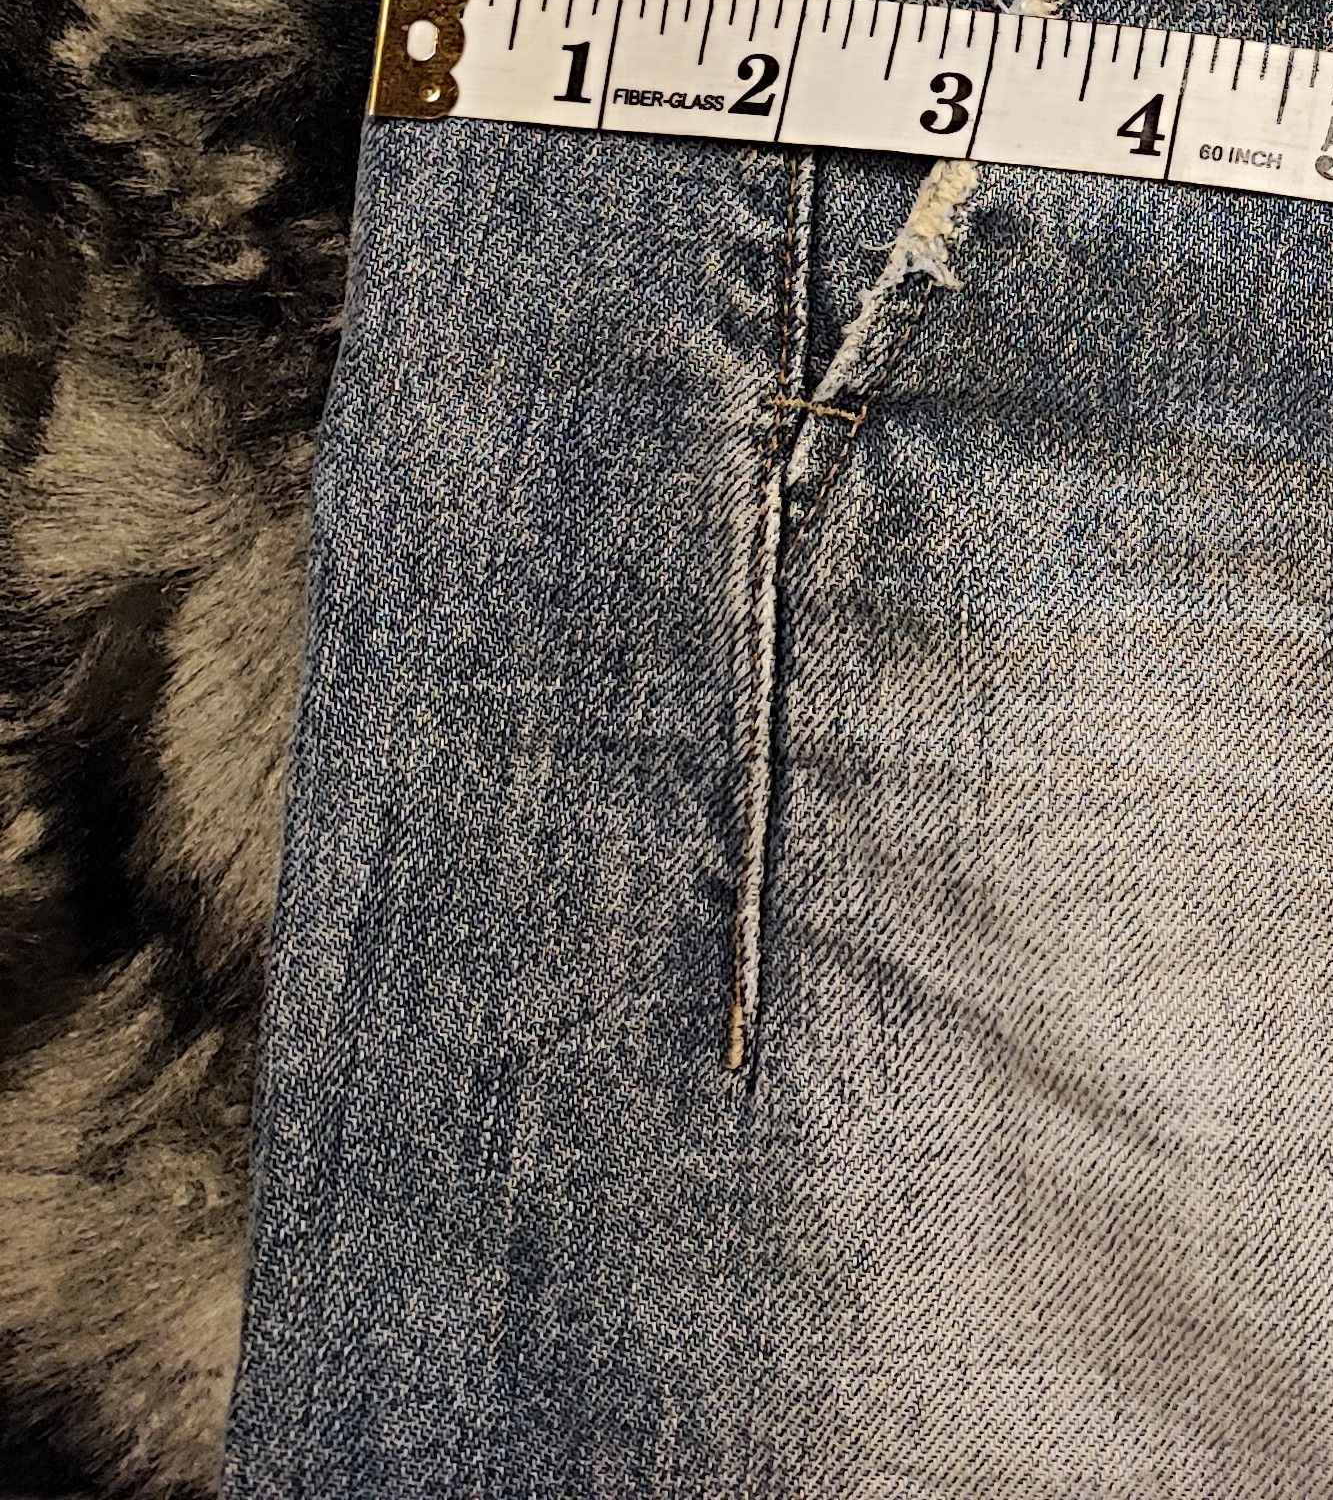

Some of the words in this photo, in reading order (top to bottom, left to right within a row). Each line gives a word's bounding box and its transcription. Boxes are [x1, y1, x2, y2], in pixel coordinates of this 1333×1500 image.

[552, 41, 592, 104] 1
[728, 53, 780, 116] 2
[919, 72, 973, 134] 3
[1116, 94, 1165, 157] 4
[613, 88, 724, 112] FIBER-GLASS
[1198, 144, 1223, 162] 60
[1227, 148, 1283, 170] INCH
